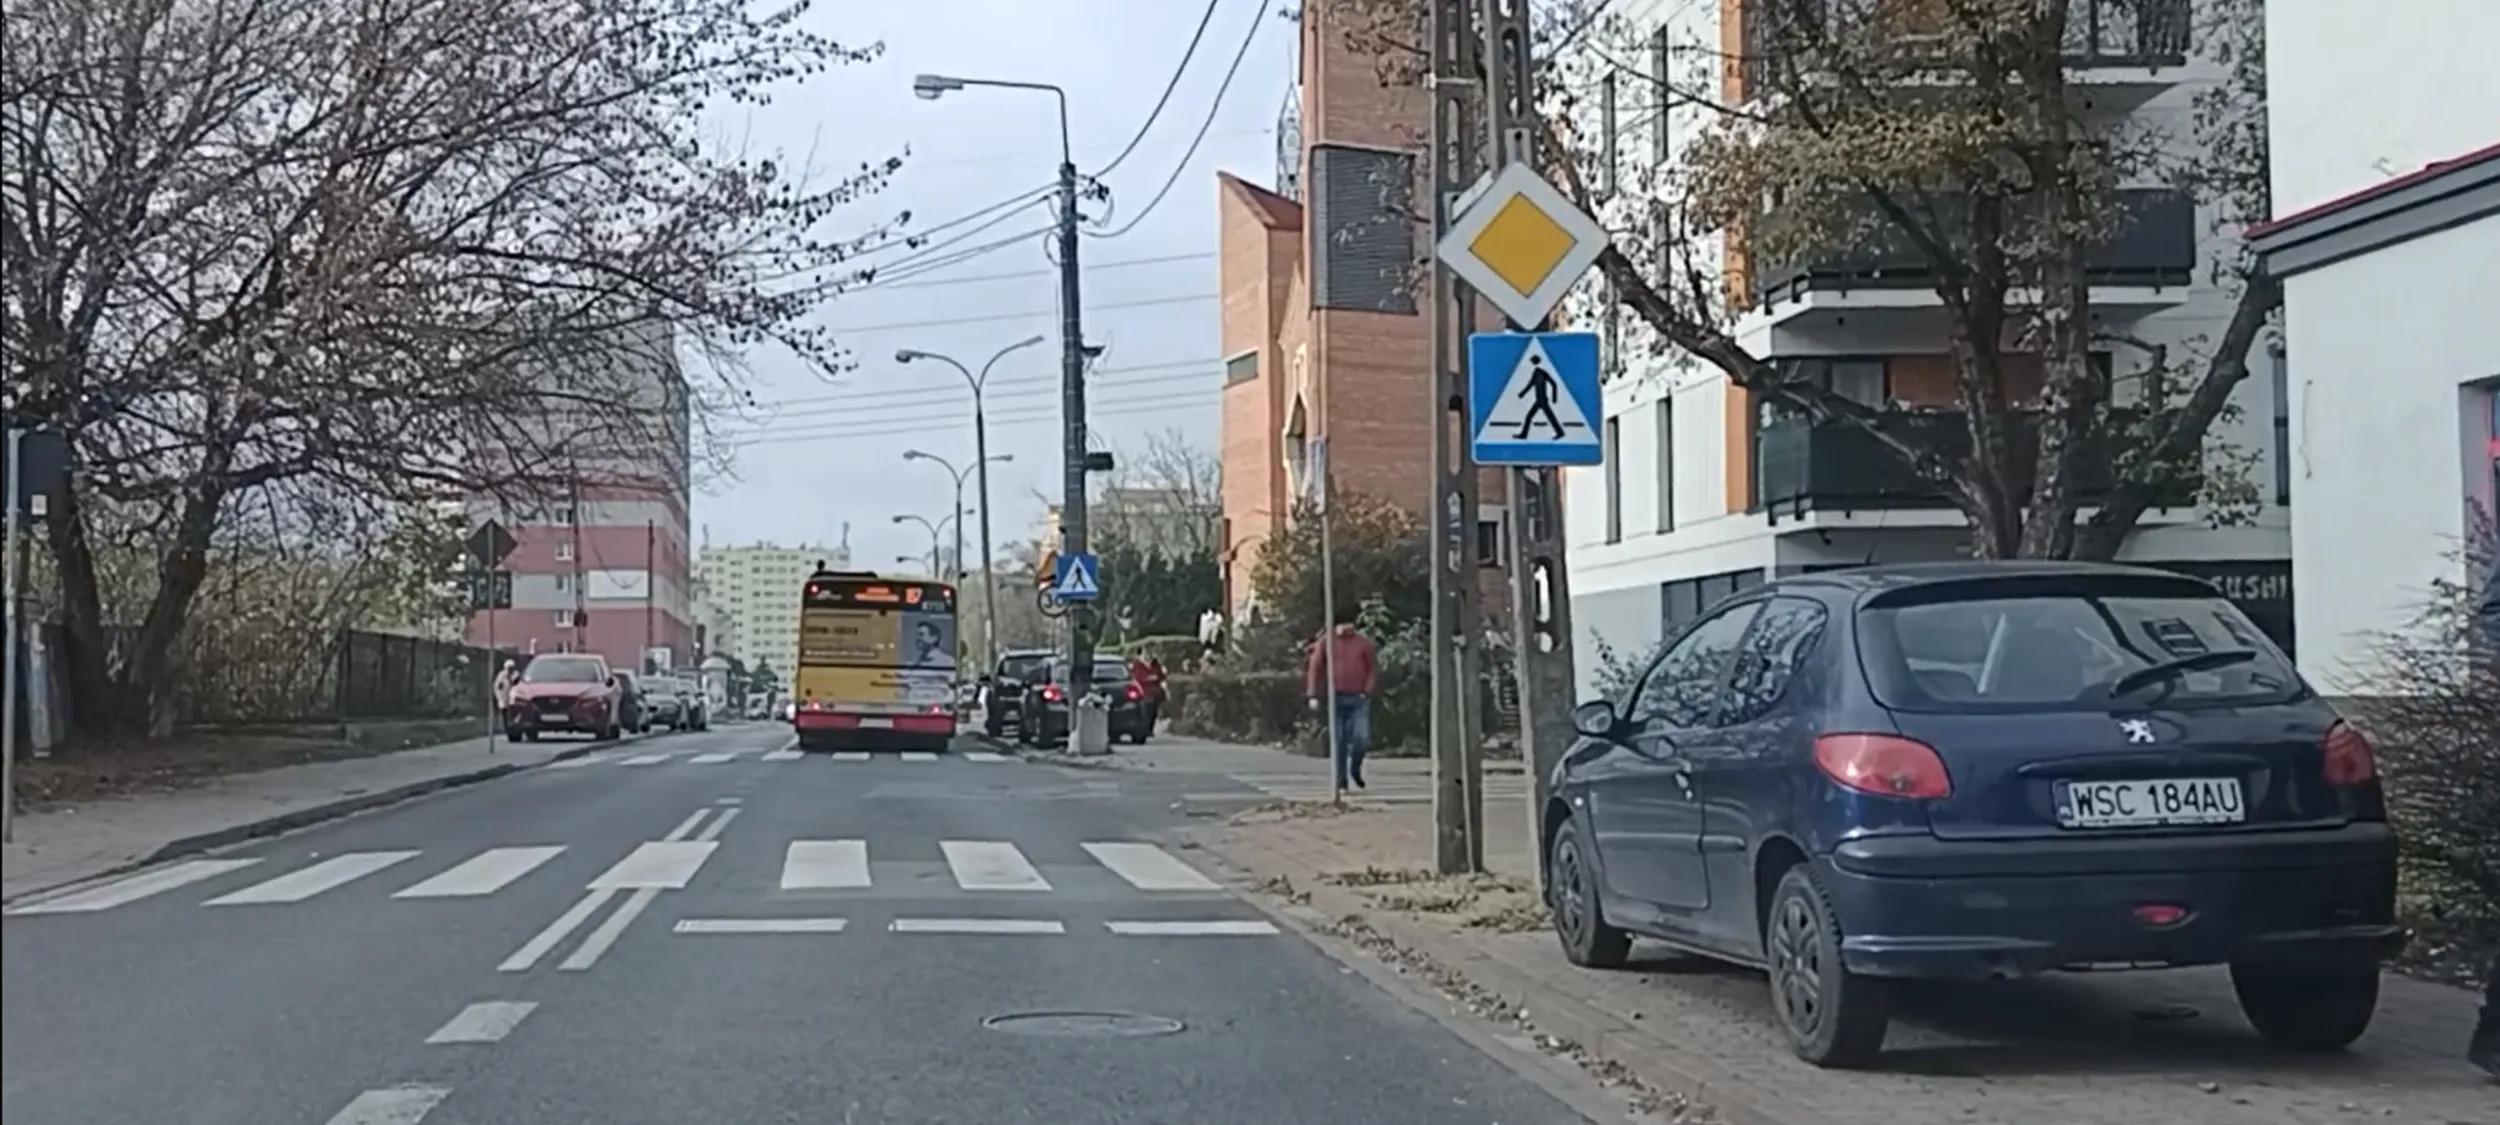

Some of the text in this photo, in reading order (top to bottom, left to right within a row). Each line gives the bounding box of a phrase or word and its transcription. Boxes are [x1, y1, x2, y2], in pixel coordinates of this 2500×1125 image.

[2211, 575, 2288, 600] SUSHI
[2072, 780, 2239, 817] WSC 184AU
